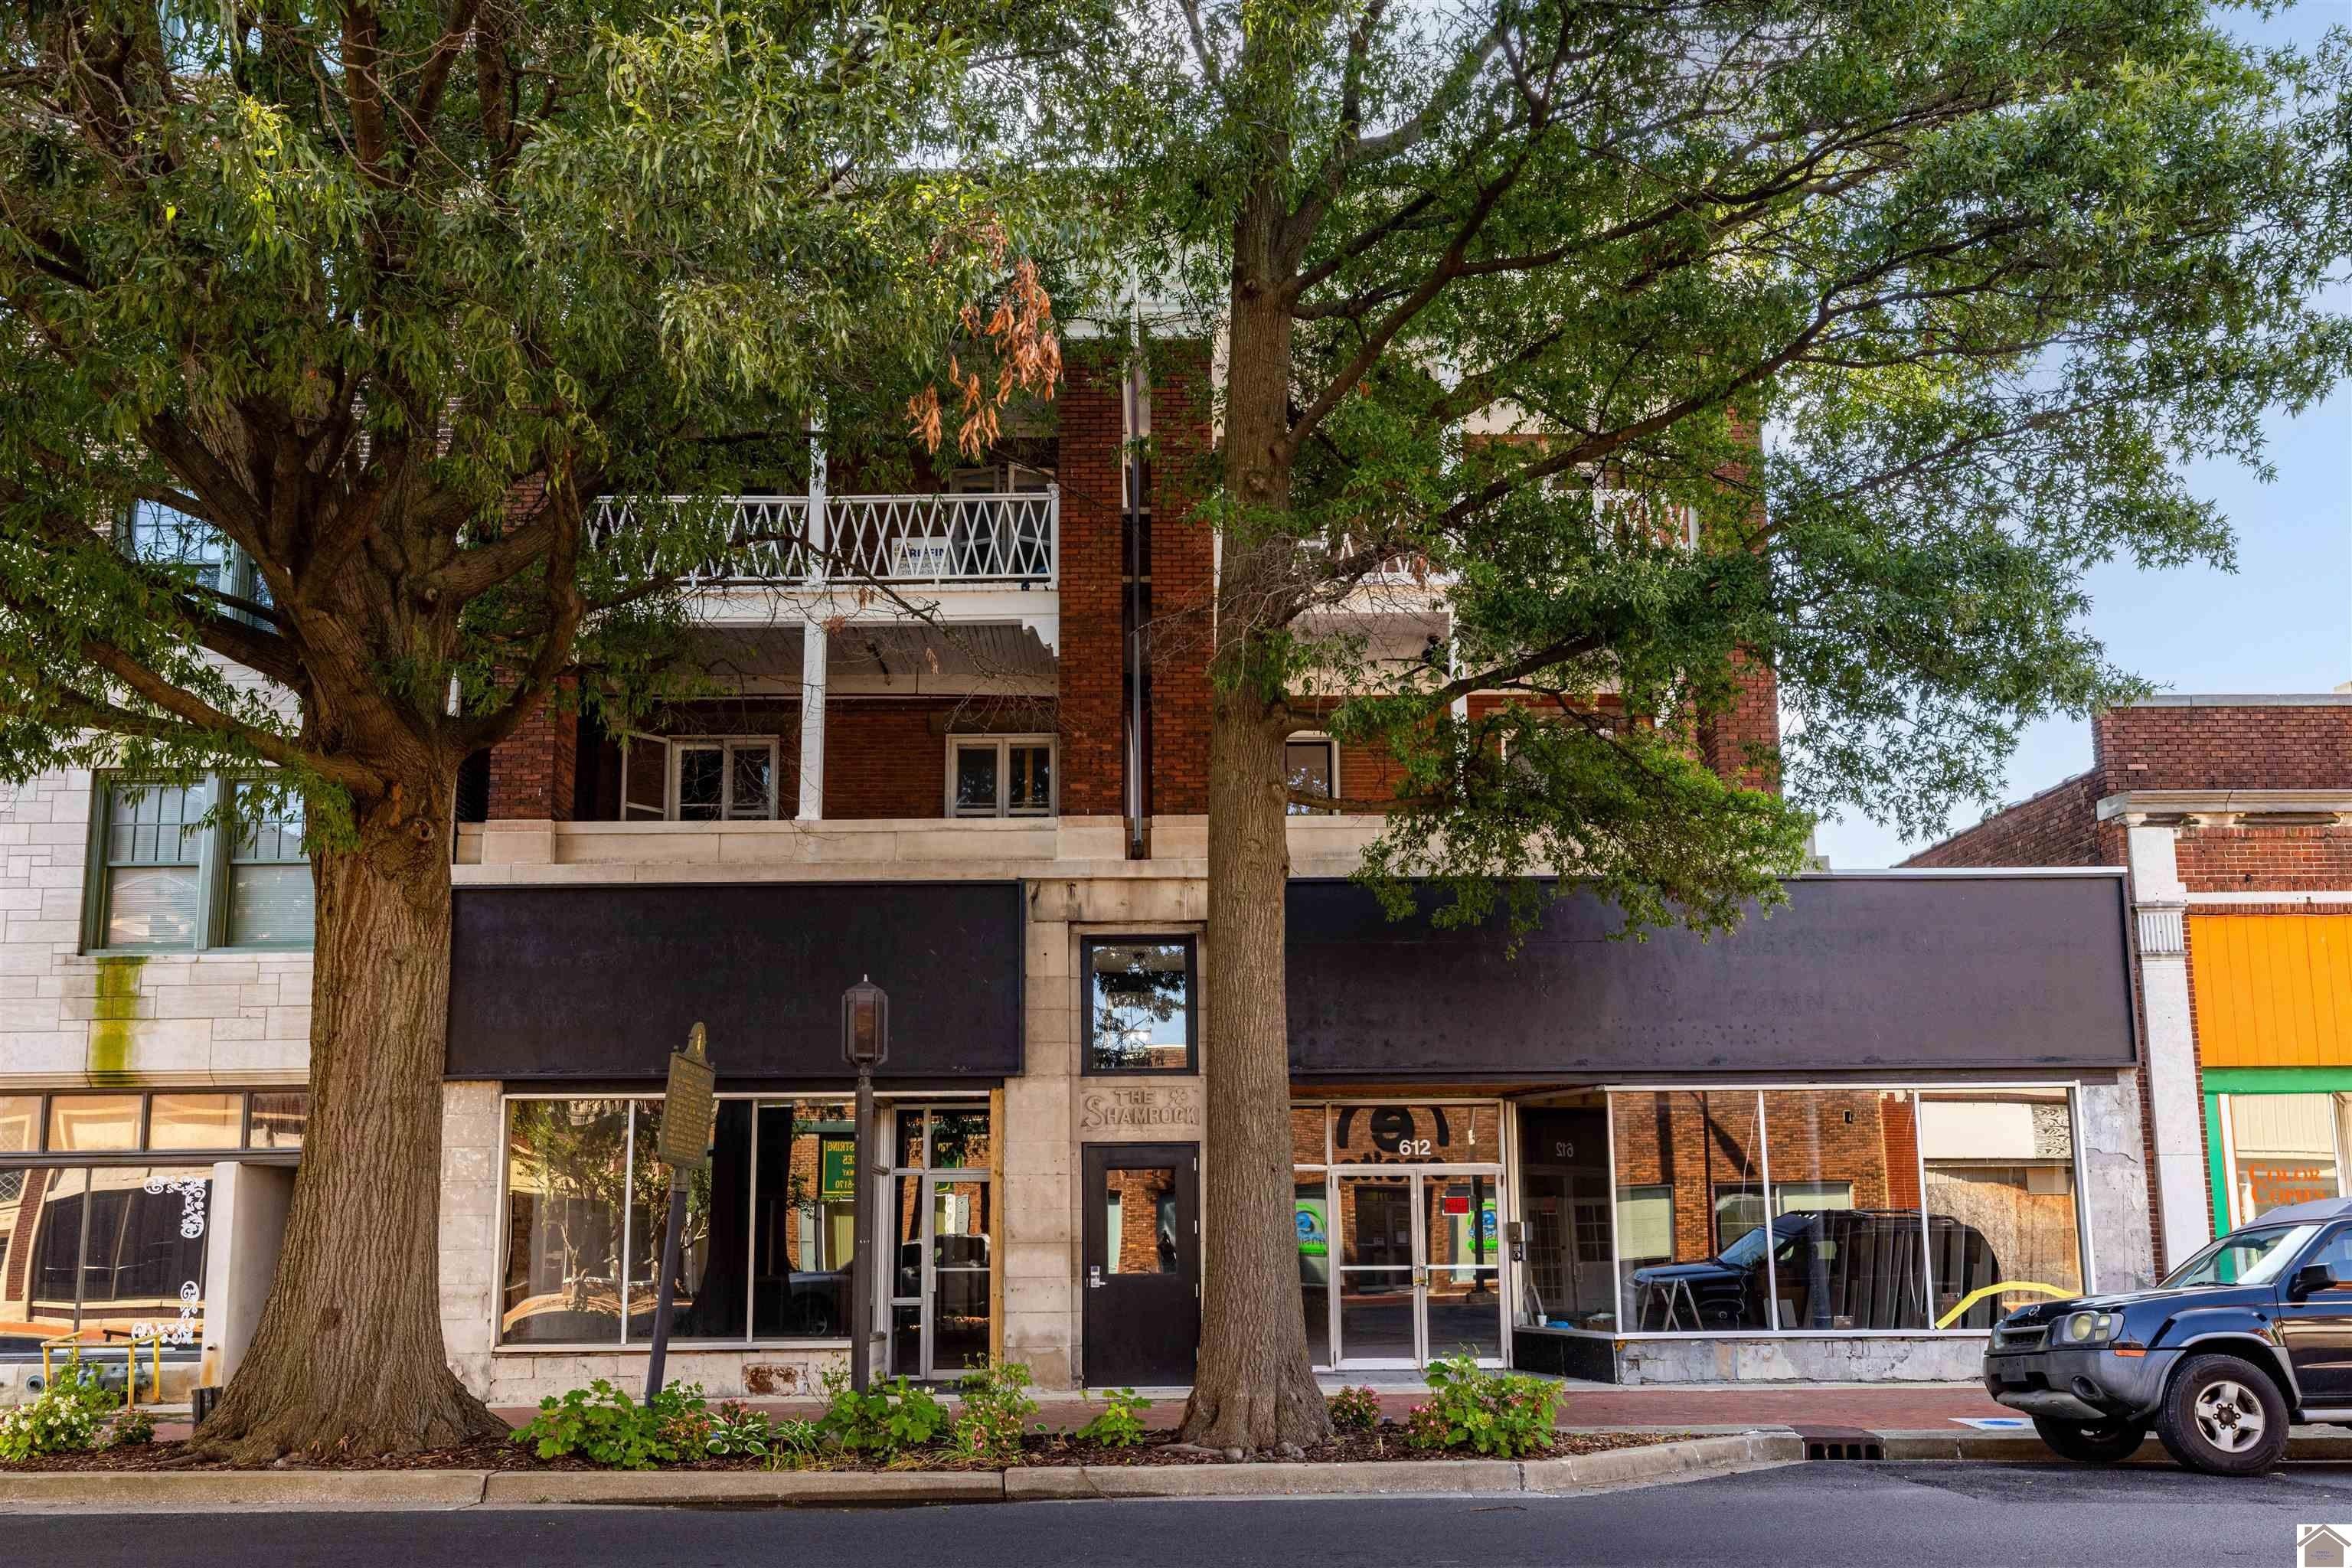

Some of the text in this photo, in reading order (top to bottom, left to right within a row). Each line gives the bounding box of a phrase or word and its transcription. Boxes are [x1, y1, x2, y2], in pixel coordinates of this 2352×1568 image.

[1114, 1089, 1155, 1106] THE
[1081, 1096, 1200, 1129] SHAMROCK
[1399, 1139, 1431, 1155] 612
